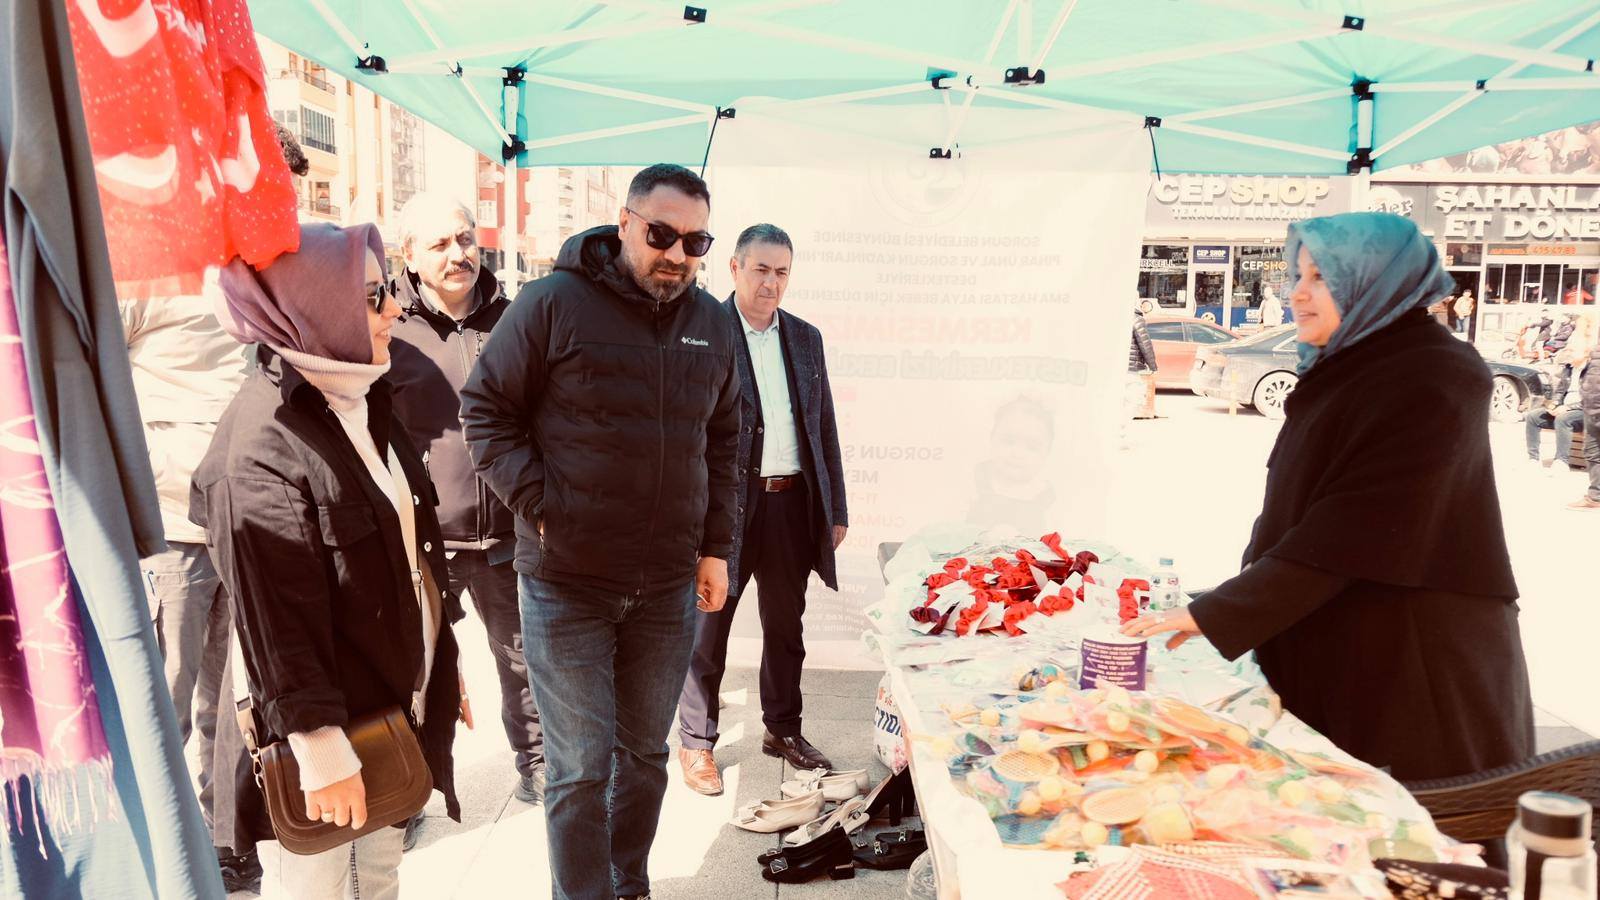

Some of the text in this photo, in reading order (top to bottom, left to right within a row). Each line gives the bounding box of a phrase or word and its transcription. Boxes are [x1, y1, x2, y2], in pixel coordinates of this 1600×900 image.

[1154, 176, 1329, 206] CEP SHOP
[1433, 186, 1600, 213] ŞAHANL
[1444, 208, 1600, 241] ET DÖNE
[1196, 250, 1209, 258] CEP
[1210, 250, 1227, 258] SHOP
[686, 337, 709, 346] Columbia
